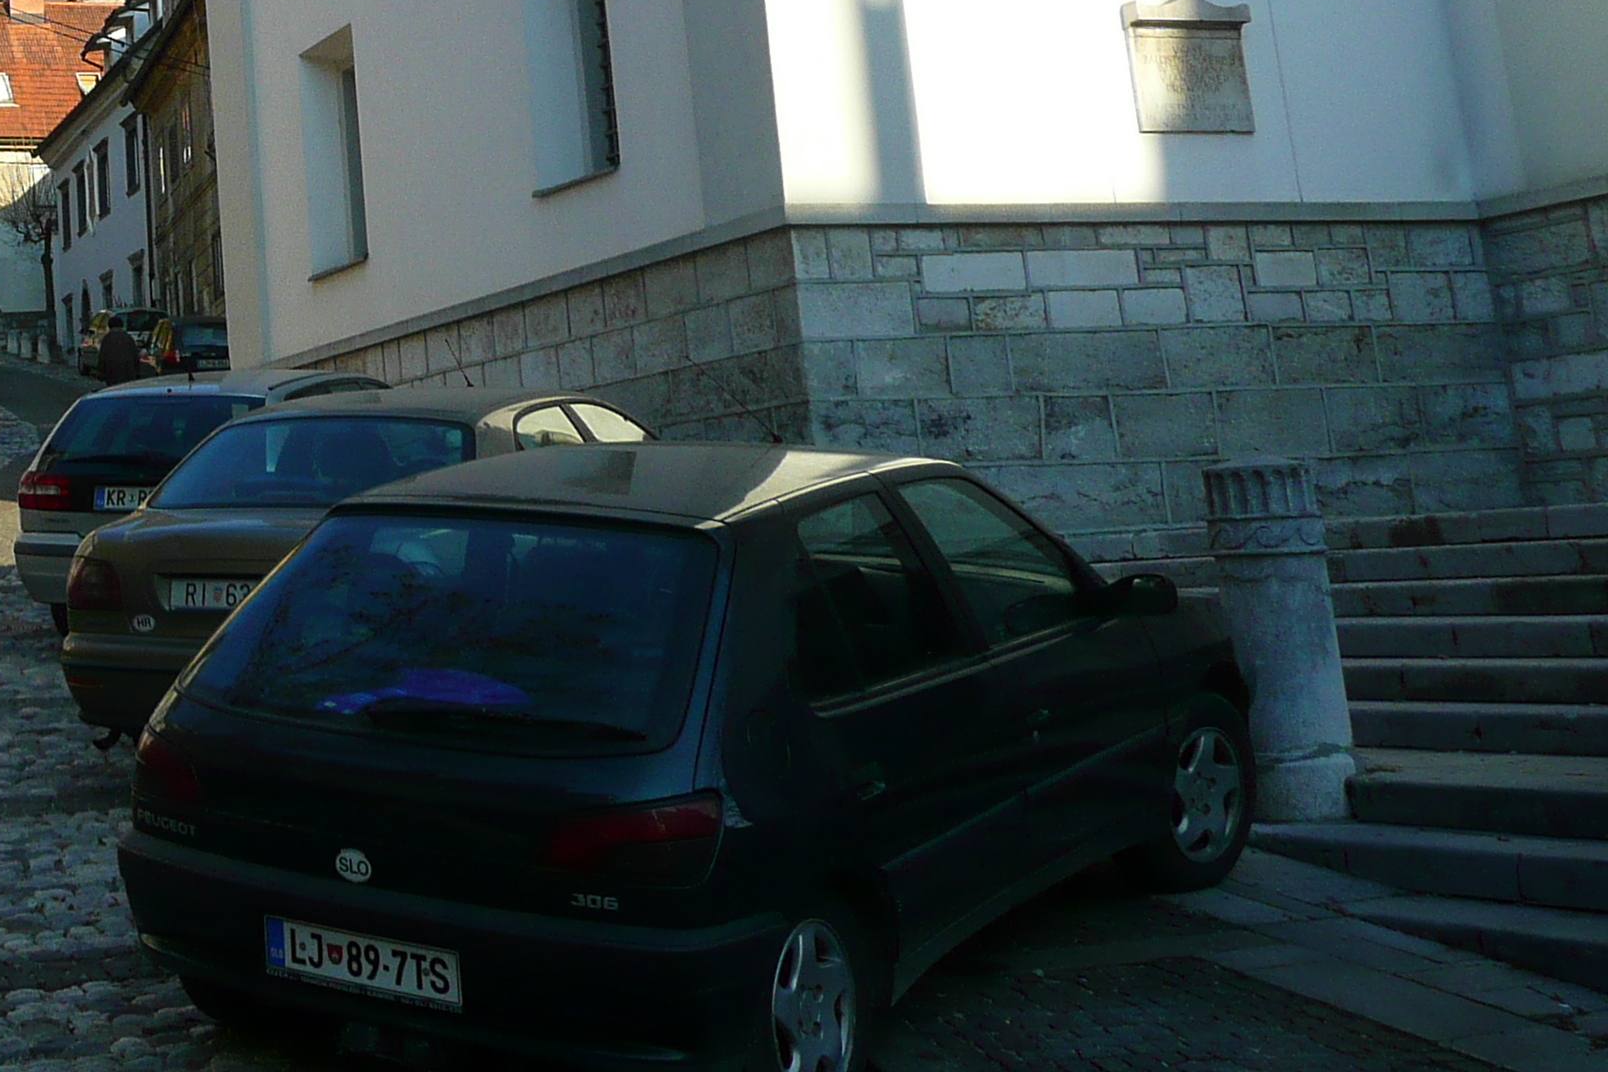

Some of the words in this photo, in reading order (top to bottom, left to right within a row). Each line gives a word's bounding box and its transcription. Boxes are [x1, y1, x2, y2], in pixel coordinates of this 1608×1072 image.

[106, 489, 127, 506] KR
[185, 582, 206, 607] RI
[136, 617, 152, 628] HR
[137, 808, 197, 837] PEUGEOT
[338, 856, 370, 877] SLO
[570, 892, 619, 910] 306
[289, 927, 323, 969] LJ
[346, 940, 450, 995] 89-7TS
